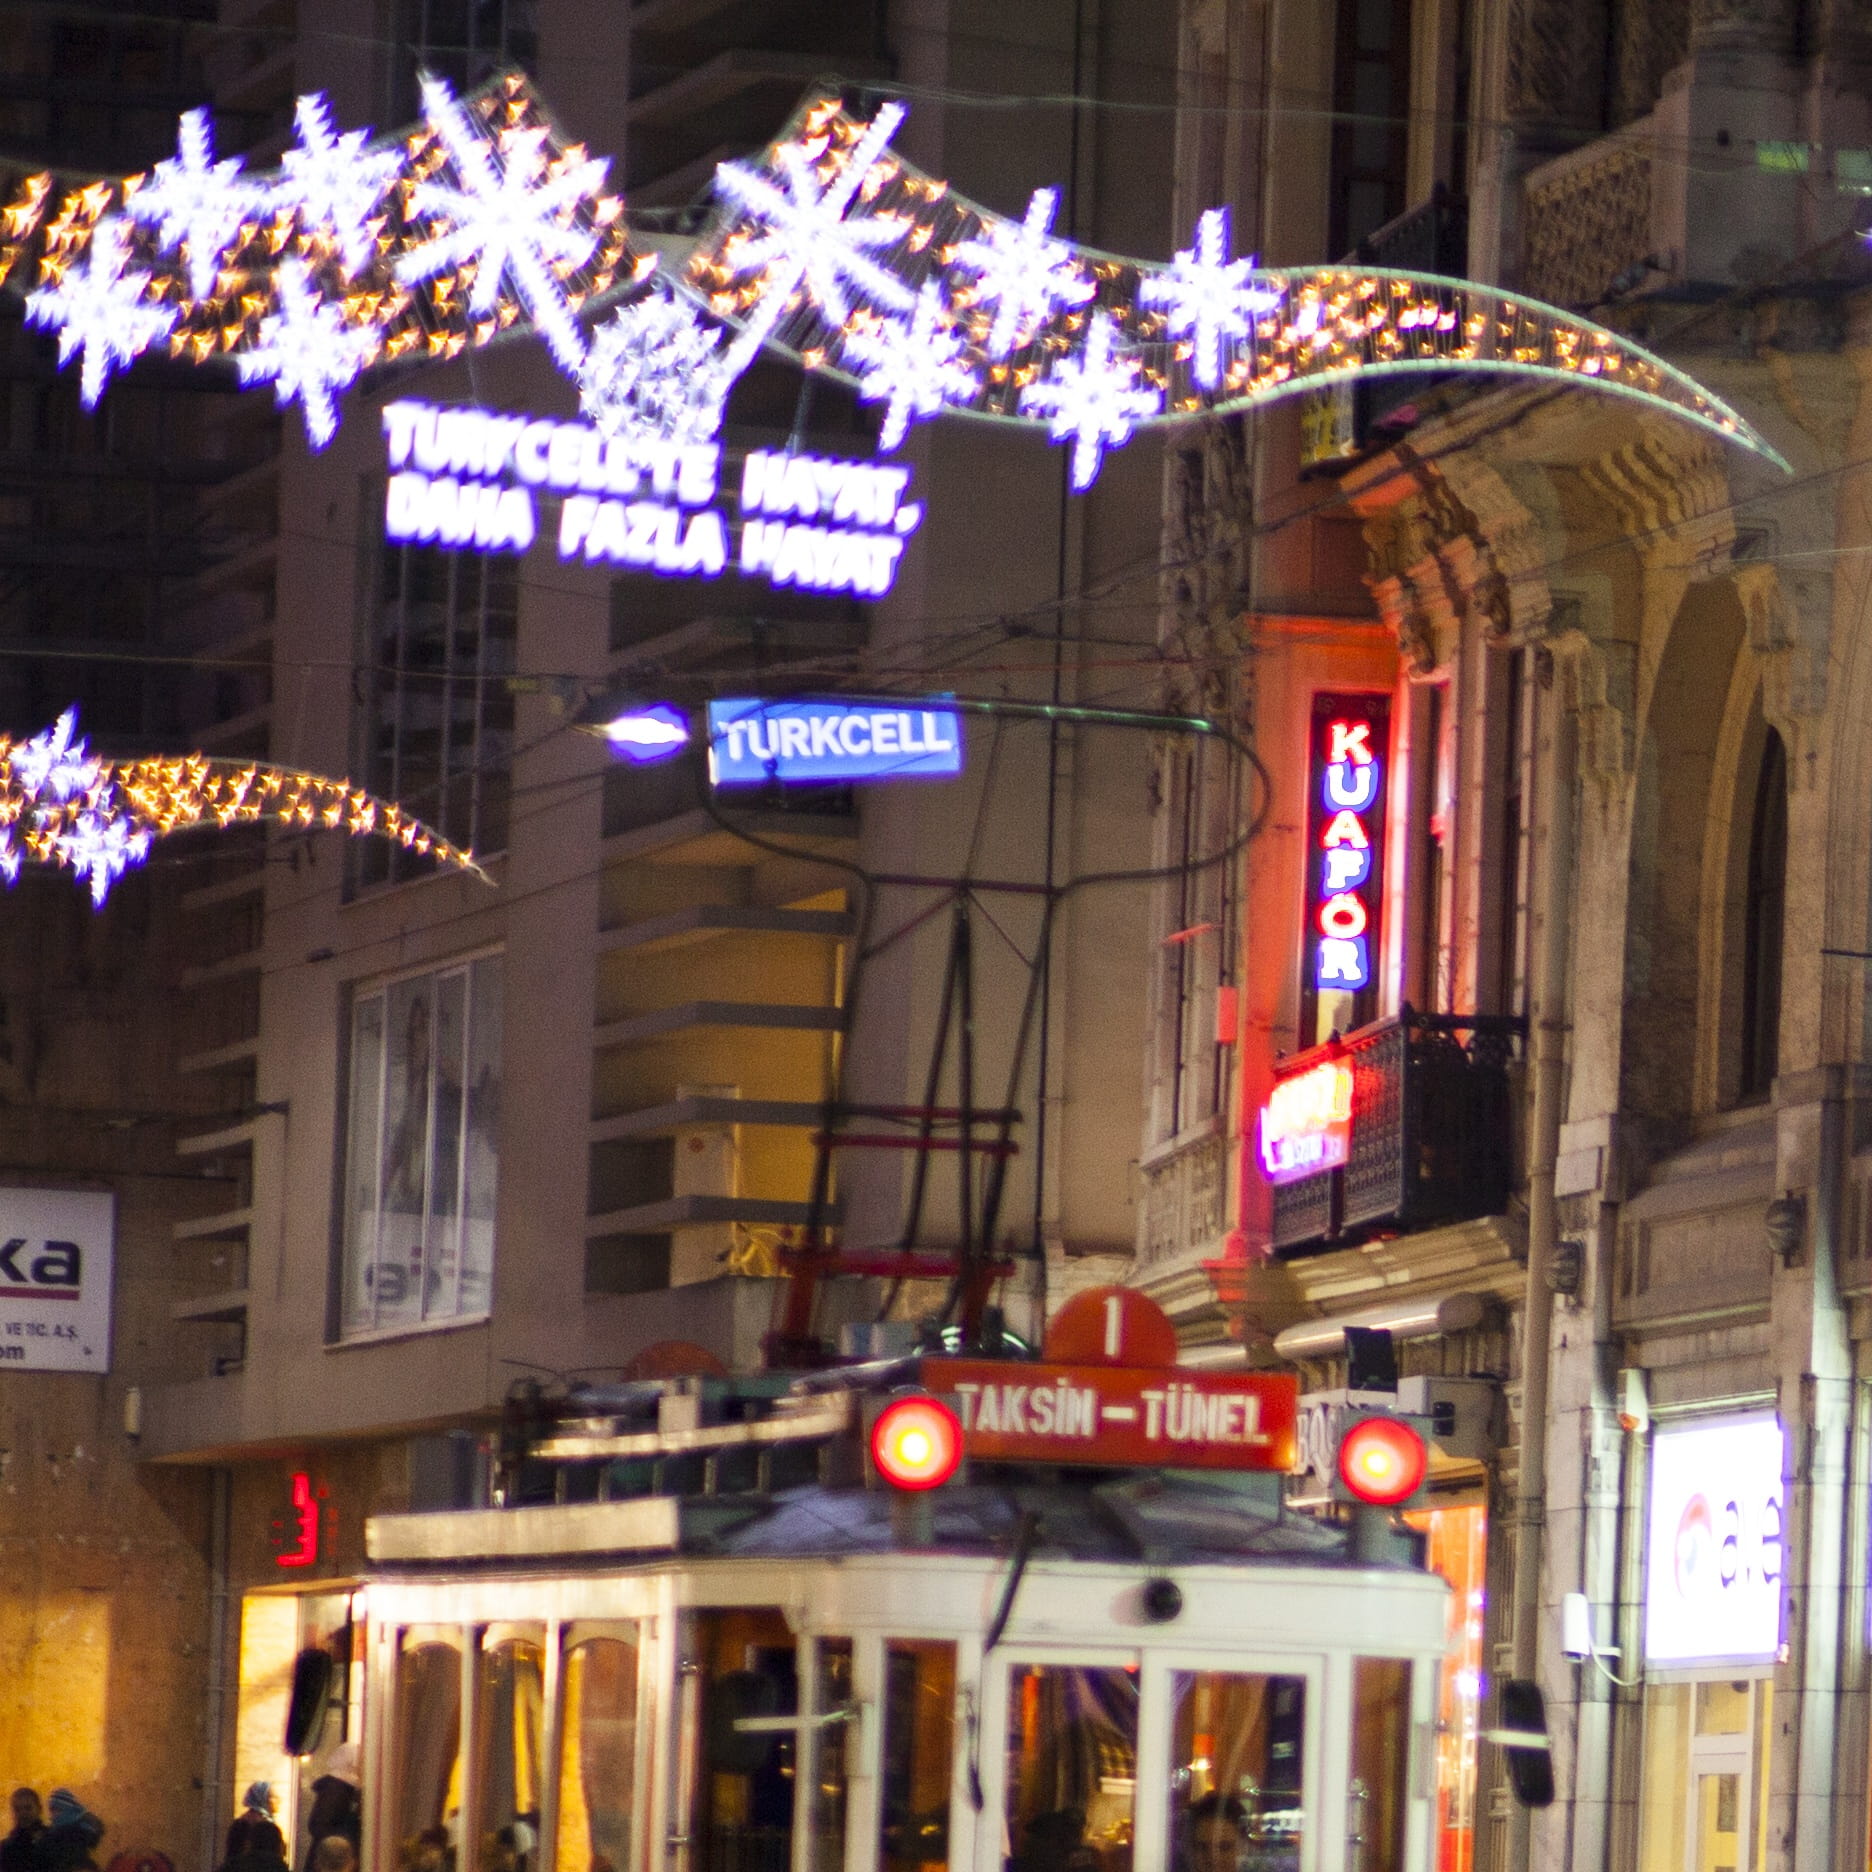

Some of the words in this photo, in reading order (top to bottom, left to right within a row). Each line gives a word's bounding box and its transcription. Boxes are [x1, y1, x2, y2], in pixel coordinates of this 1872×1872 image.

[741, 450, 924, 536] HAYAT,
[386, 471, 538, 553] DAHA
[557, 496, 731, 578] FAZLA
[740, 520, 902, 598] HAYAT
[717, 710, 951, 761] TURKCELL
[1103, 1296, 1121, 1357] 1
[955, 1377, 1097, 1437] TAKSİM
[1140, 1382, 1270, 1443] TÜNEL
